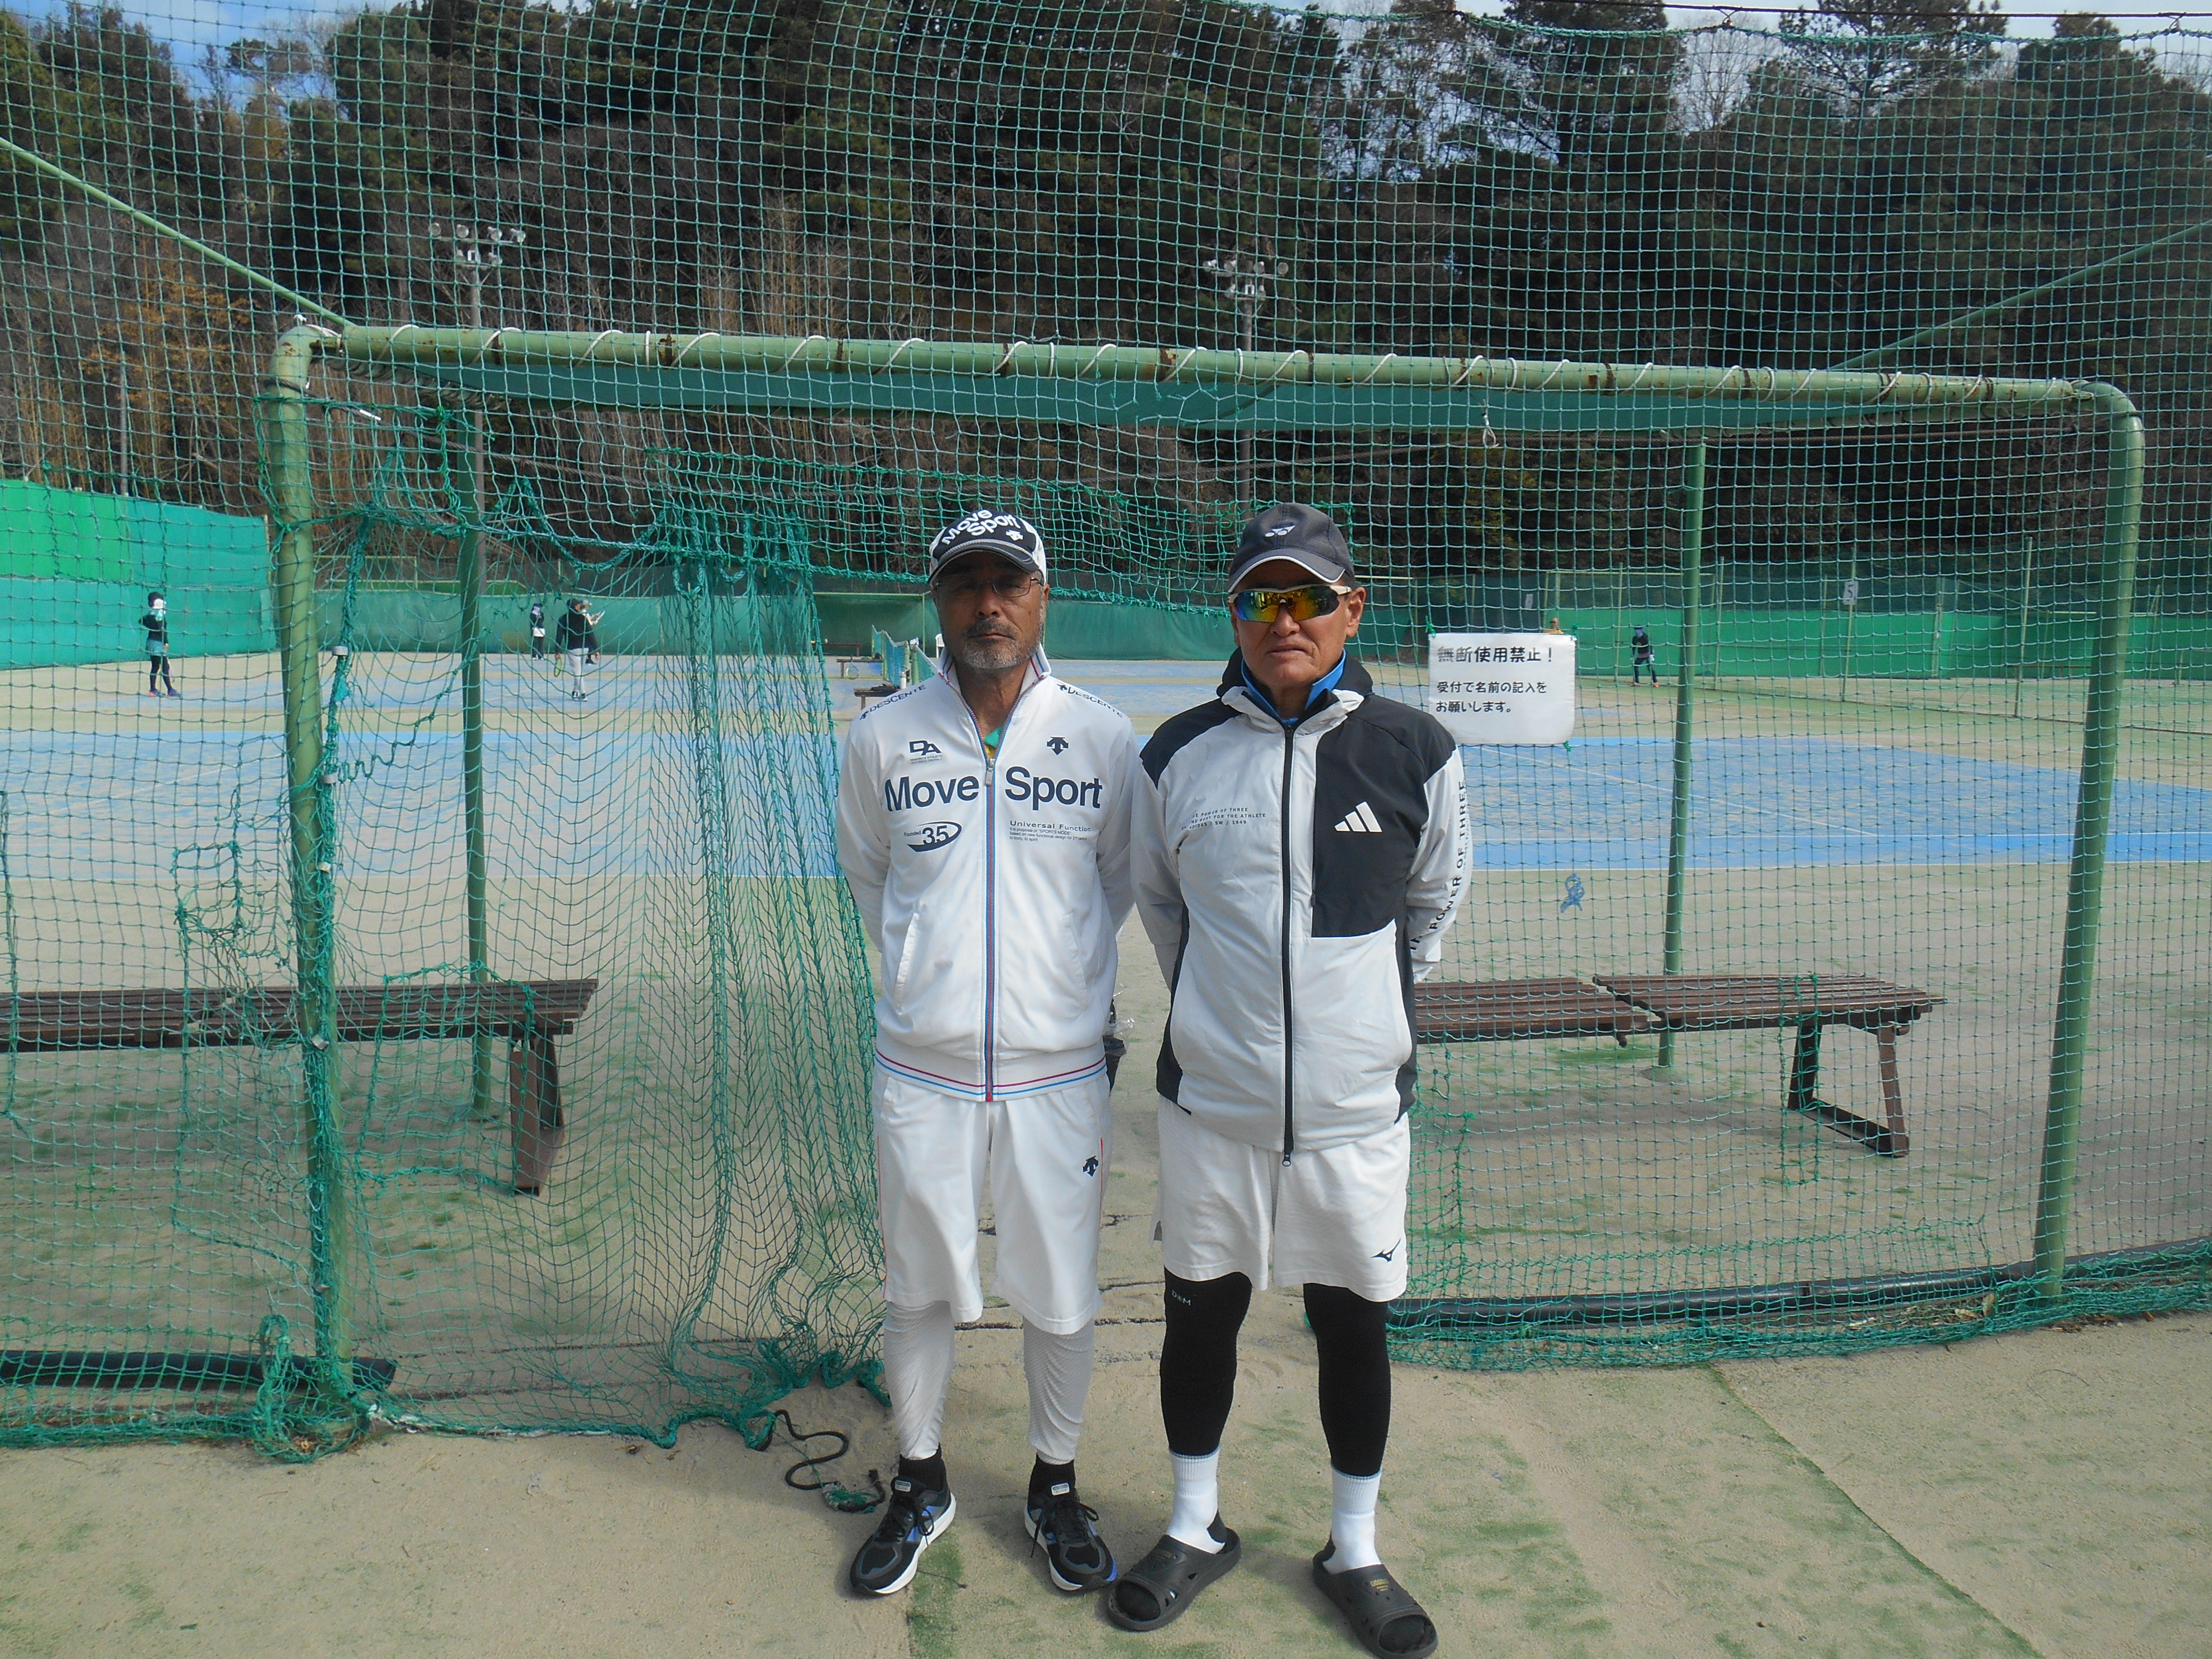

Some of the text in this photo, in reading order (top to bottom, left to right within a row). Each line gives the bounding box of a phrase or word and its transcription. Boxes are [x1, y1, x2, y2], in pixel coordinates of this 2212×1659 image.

[941, 509, 993, 545] Move
[966, 514, 1021, 536] Sport
[1847, 584, 1854, 601] 5
[869, 684, 927, 712] DESCENTE
[1436, 681, 1547, 694] 受付で名前の記入を
[1436, 701, 1512, 713] お願いします。
[884, 766, 1103, 811] Move Sport
[922, 825, 950, 845] 35
[1010, 820, 1091, 832] Universal Function
[1428, 876, 1462, 930] POWER
[1456, 848, 1464, 869] OF
